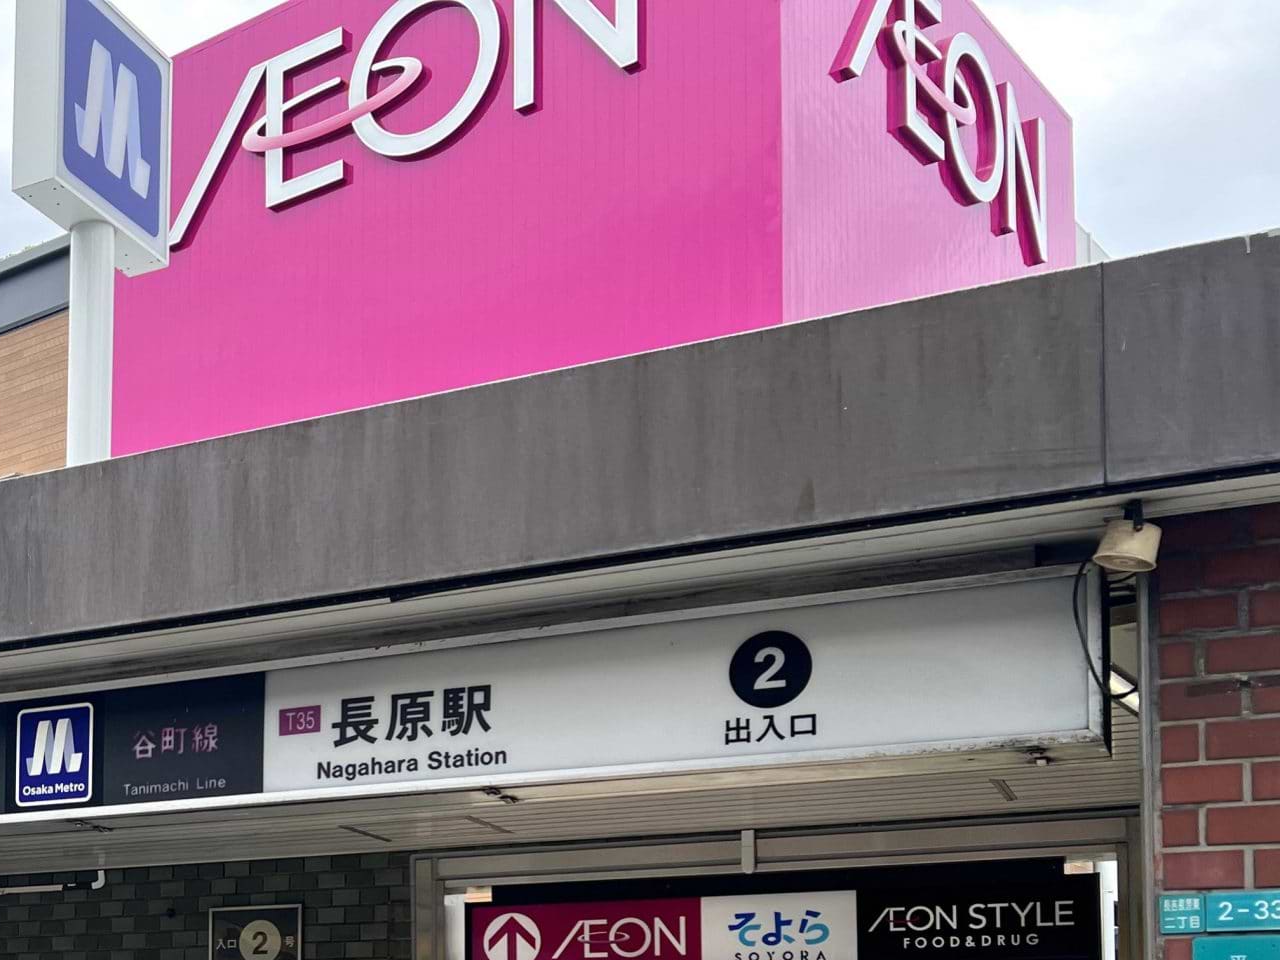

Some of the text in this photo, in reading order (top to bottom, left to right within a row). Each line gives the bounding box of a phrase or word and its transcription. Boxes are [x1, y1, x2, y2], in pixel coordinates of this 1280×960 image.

[753, 646, 786, 690] 2
[285, 684, 492, 748] T35 長原駅
[724, 713, 817, 745] 出入口
[133, 722, 219, 760] 谷町線
[317, 747, 508, 781] Nagahara Station
[22, 781, 87, 797] Osaka Metro
[123, 777, 227, 796] Tanimachi Line
[727, 910, 831, 948] そよら
[968, 900, 1076, 931] STYLE
[1164, 915, 1201, 929] 二丁目
[251, 931, 268, 955] 2
[903, 932, 1040, 950] FOOD&DRUG
